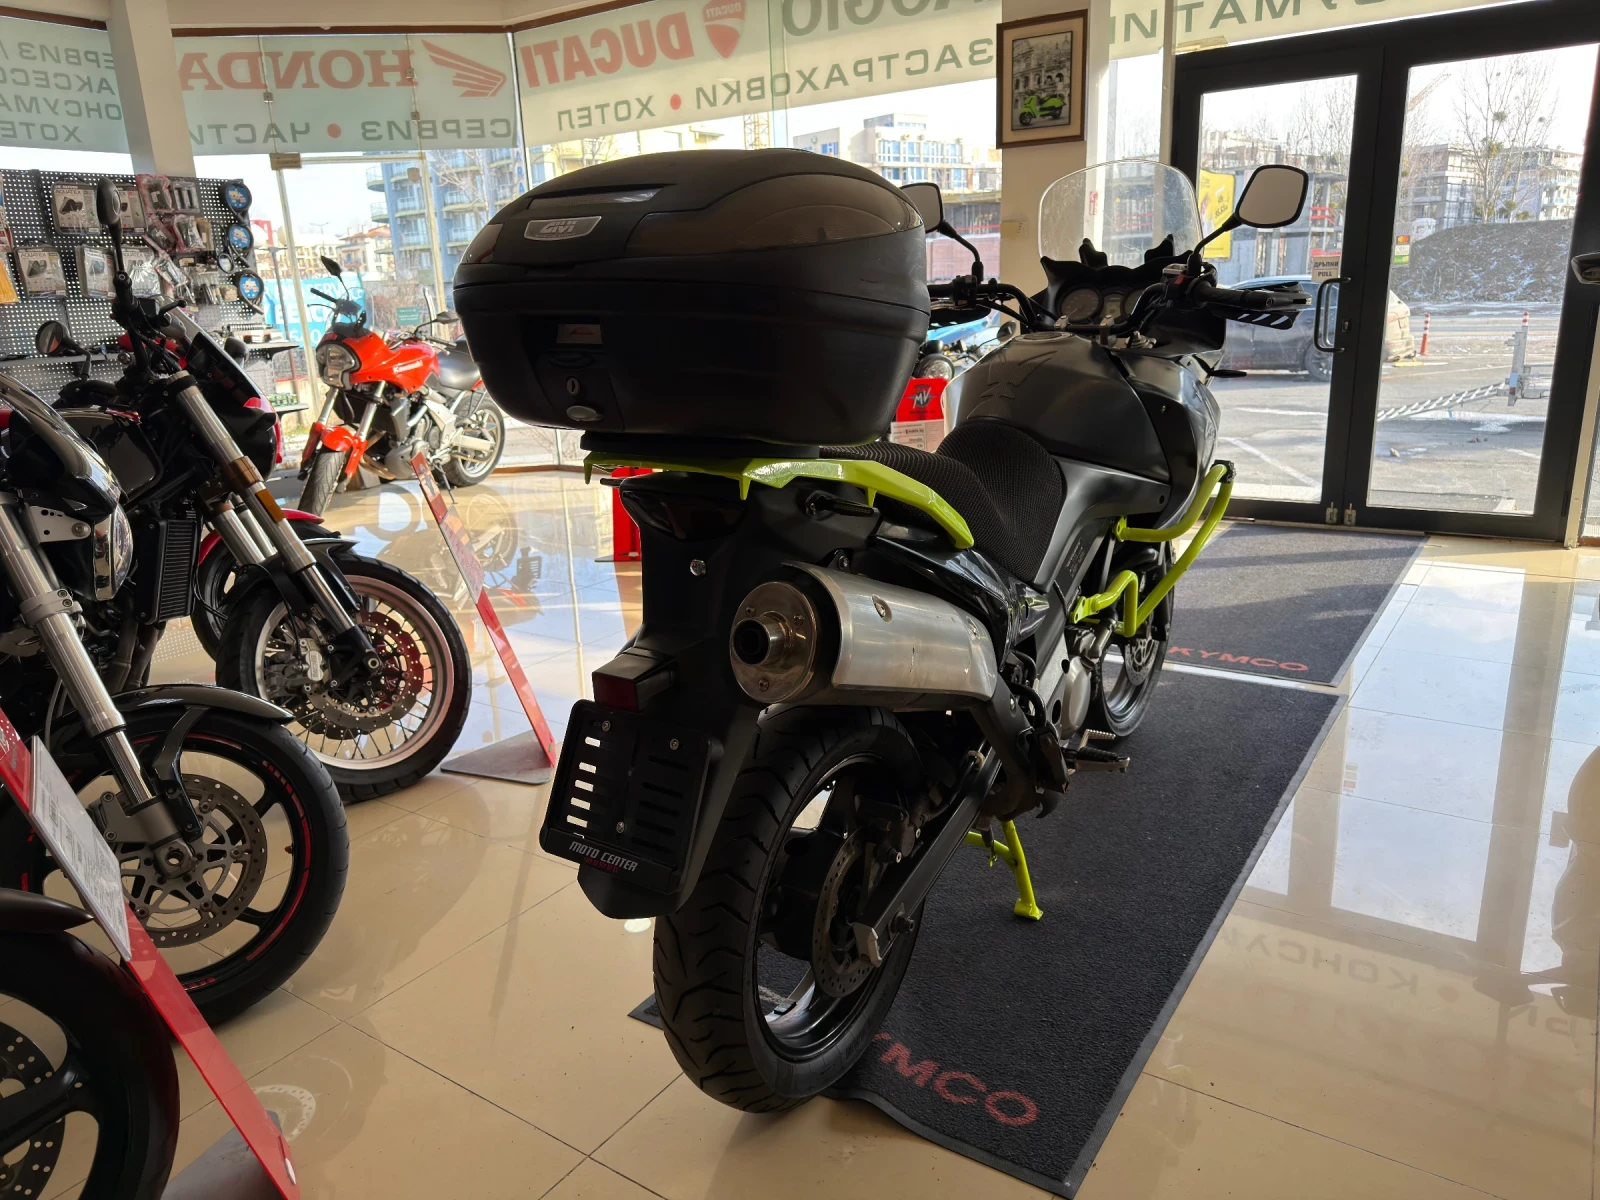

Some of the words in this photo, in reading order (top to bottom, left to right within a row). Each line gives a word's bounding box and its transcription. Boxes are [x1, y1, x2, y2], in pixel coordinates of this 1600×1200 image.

[540, 220, 577, 234] GIVI
[1313, 261, 1339, 269] ДРЪПНИ
[1168, 646, 1309, 672] KYMCO
[568, 841, 600, 859] MOTO
[600, 852, 639, 872] CENTER
[872, 1032, 1039, 1126] MCO
